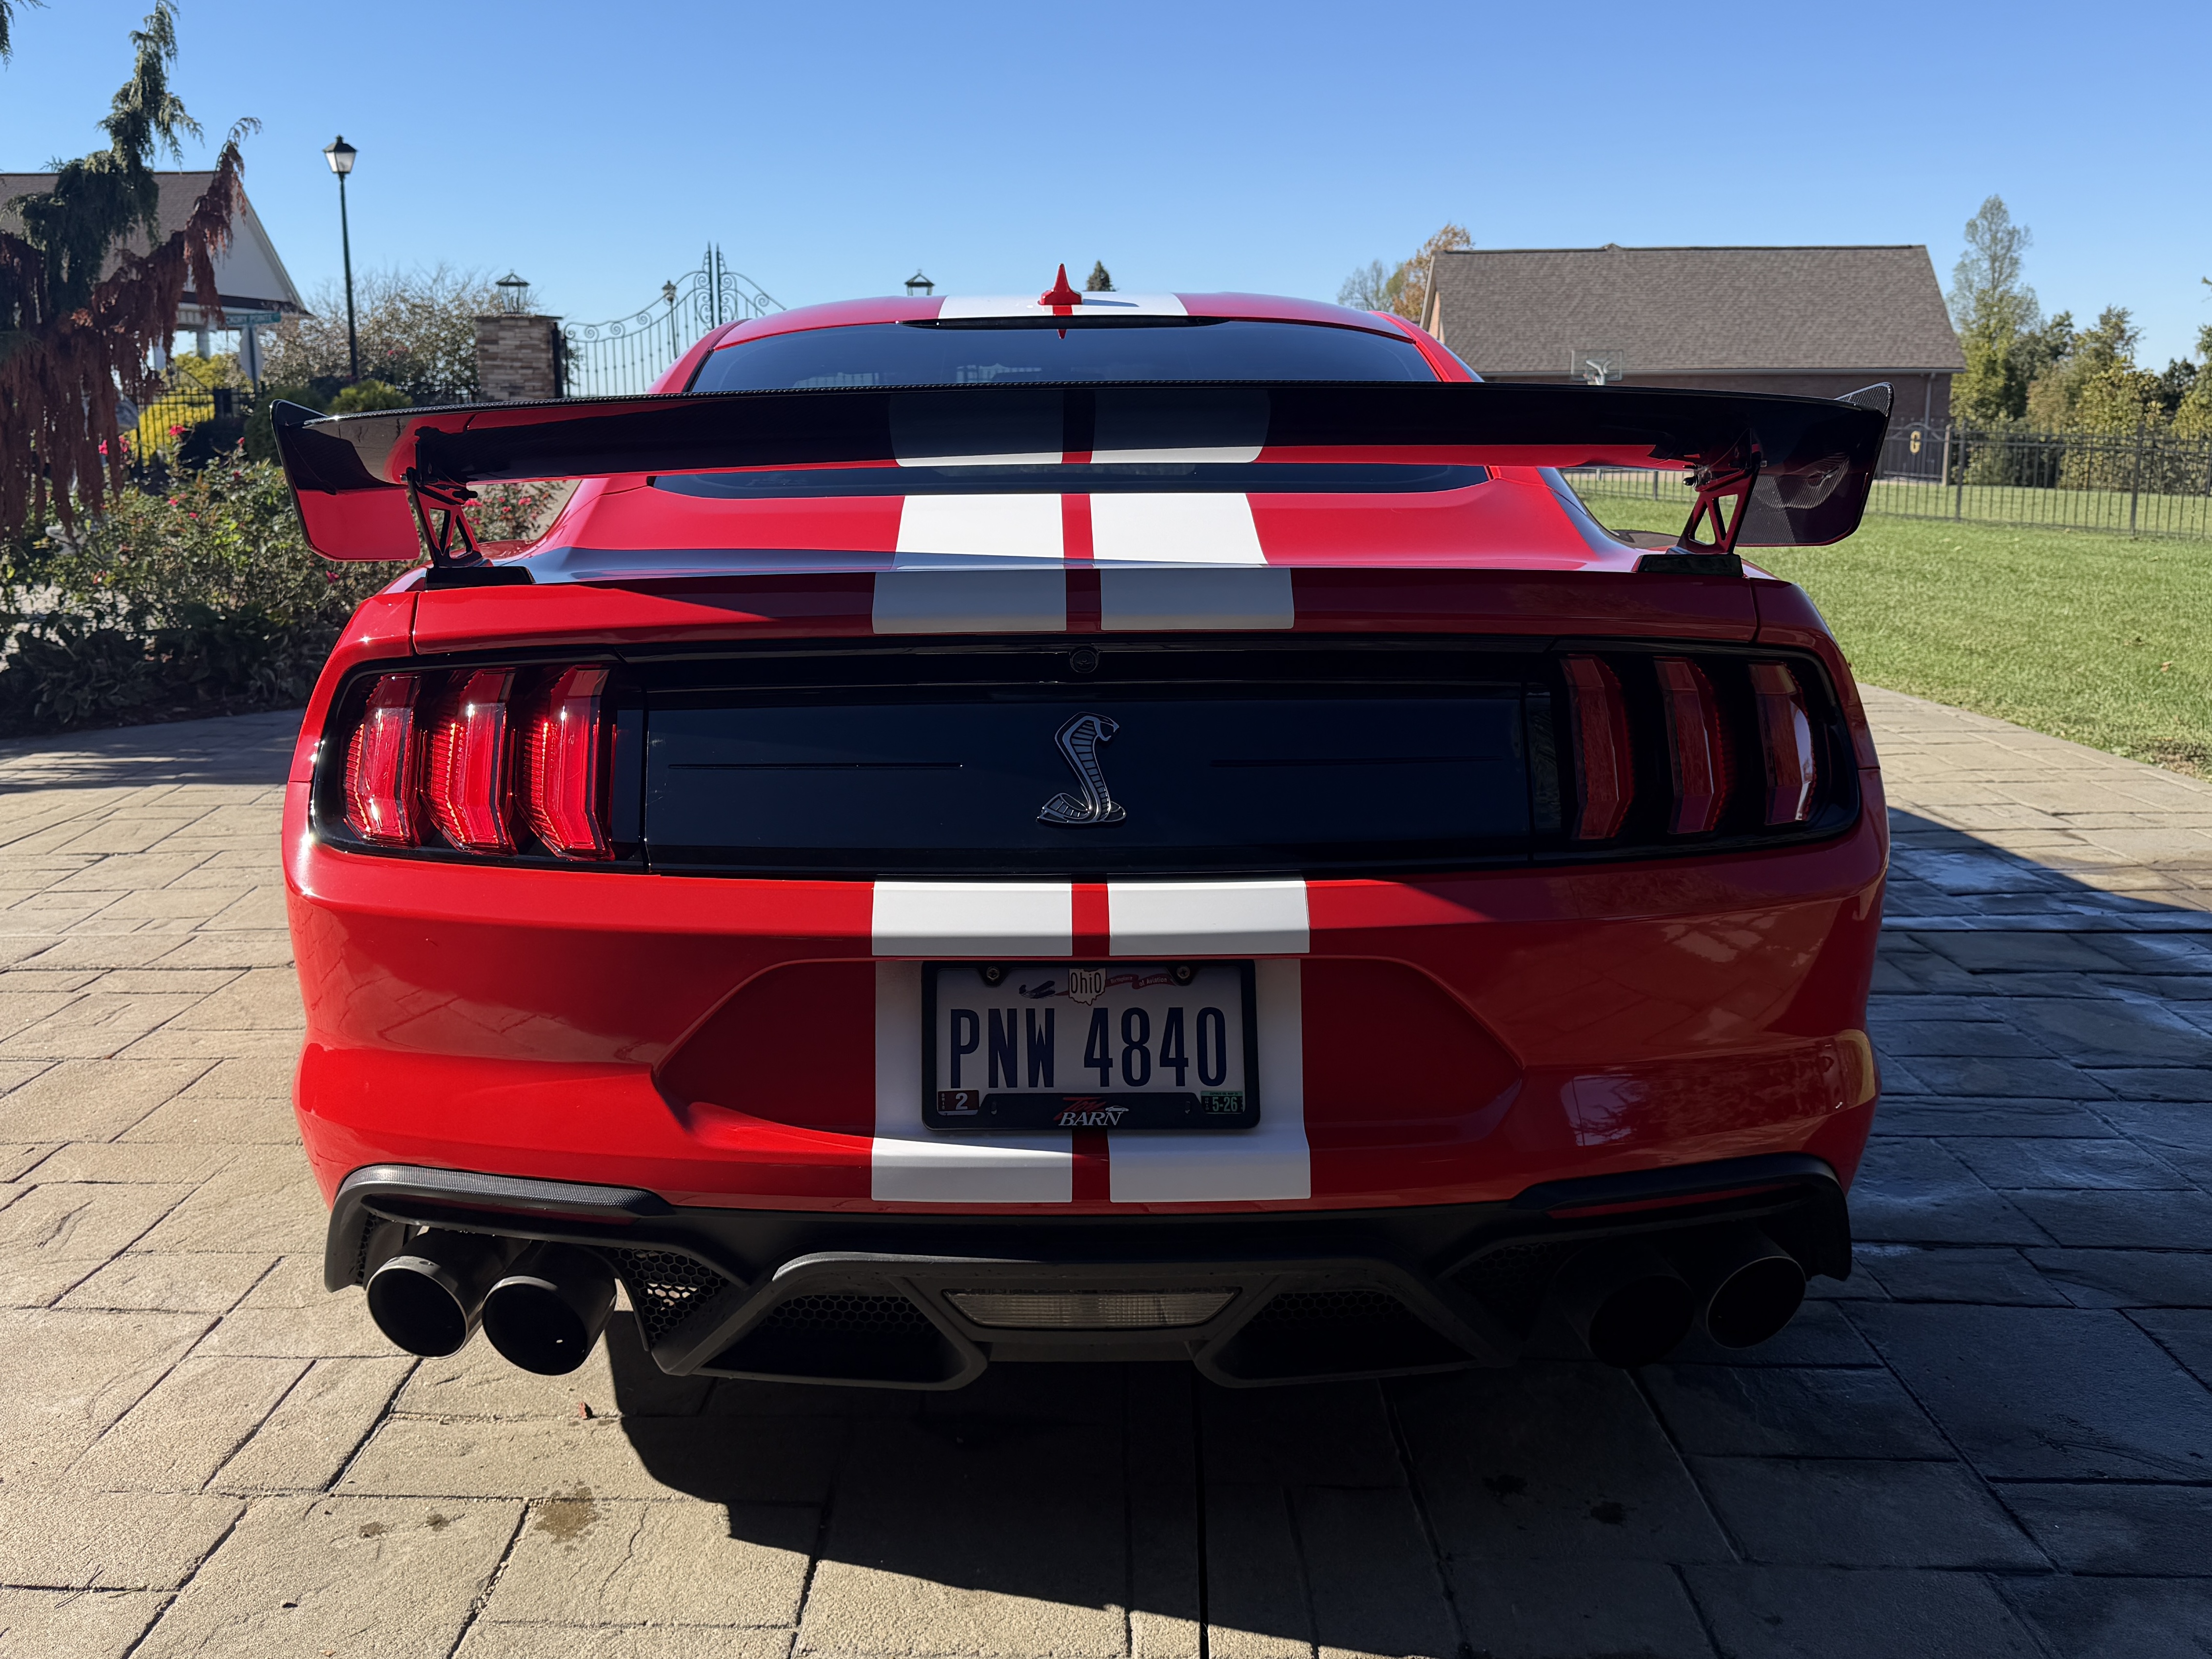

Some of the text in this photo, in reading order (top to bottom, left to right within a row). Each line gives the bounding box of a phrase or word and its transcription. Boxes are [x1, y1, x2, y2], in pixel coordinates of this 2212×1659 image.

[1910, 430, 1921, 454] G
[950, 1007, 1227, 1089] PNW 4840
[955, 1092, 968, 1110] 2
[1212, 1096, 1238, 1112] 5-26
[1058, 1112, 1124, 1126] BARN
